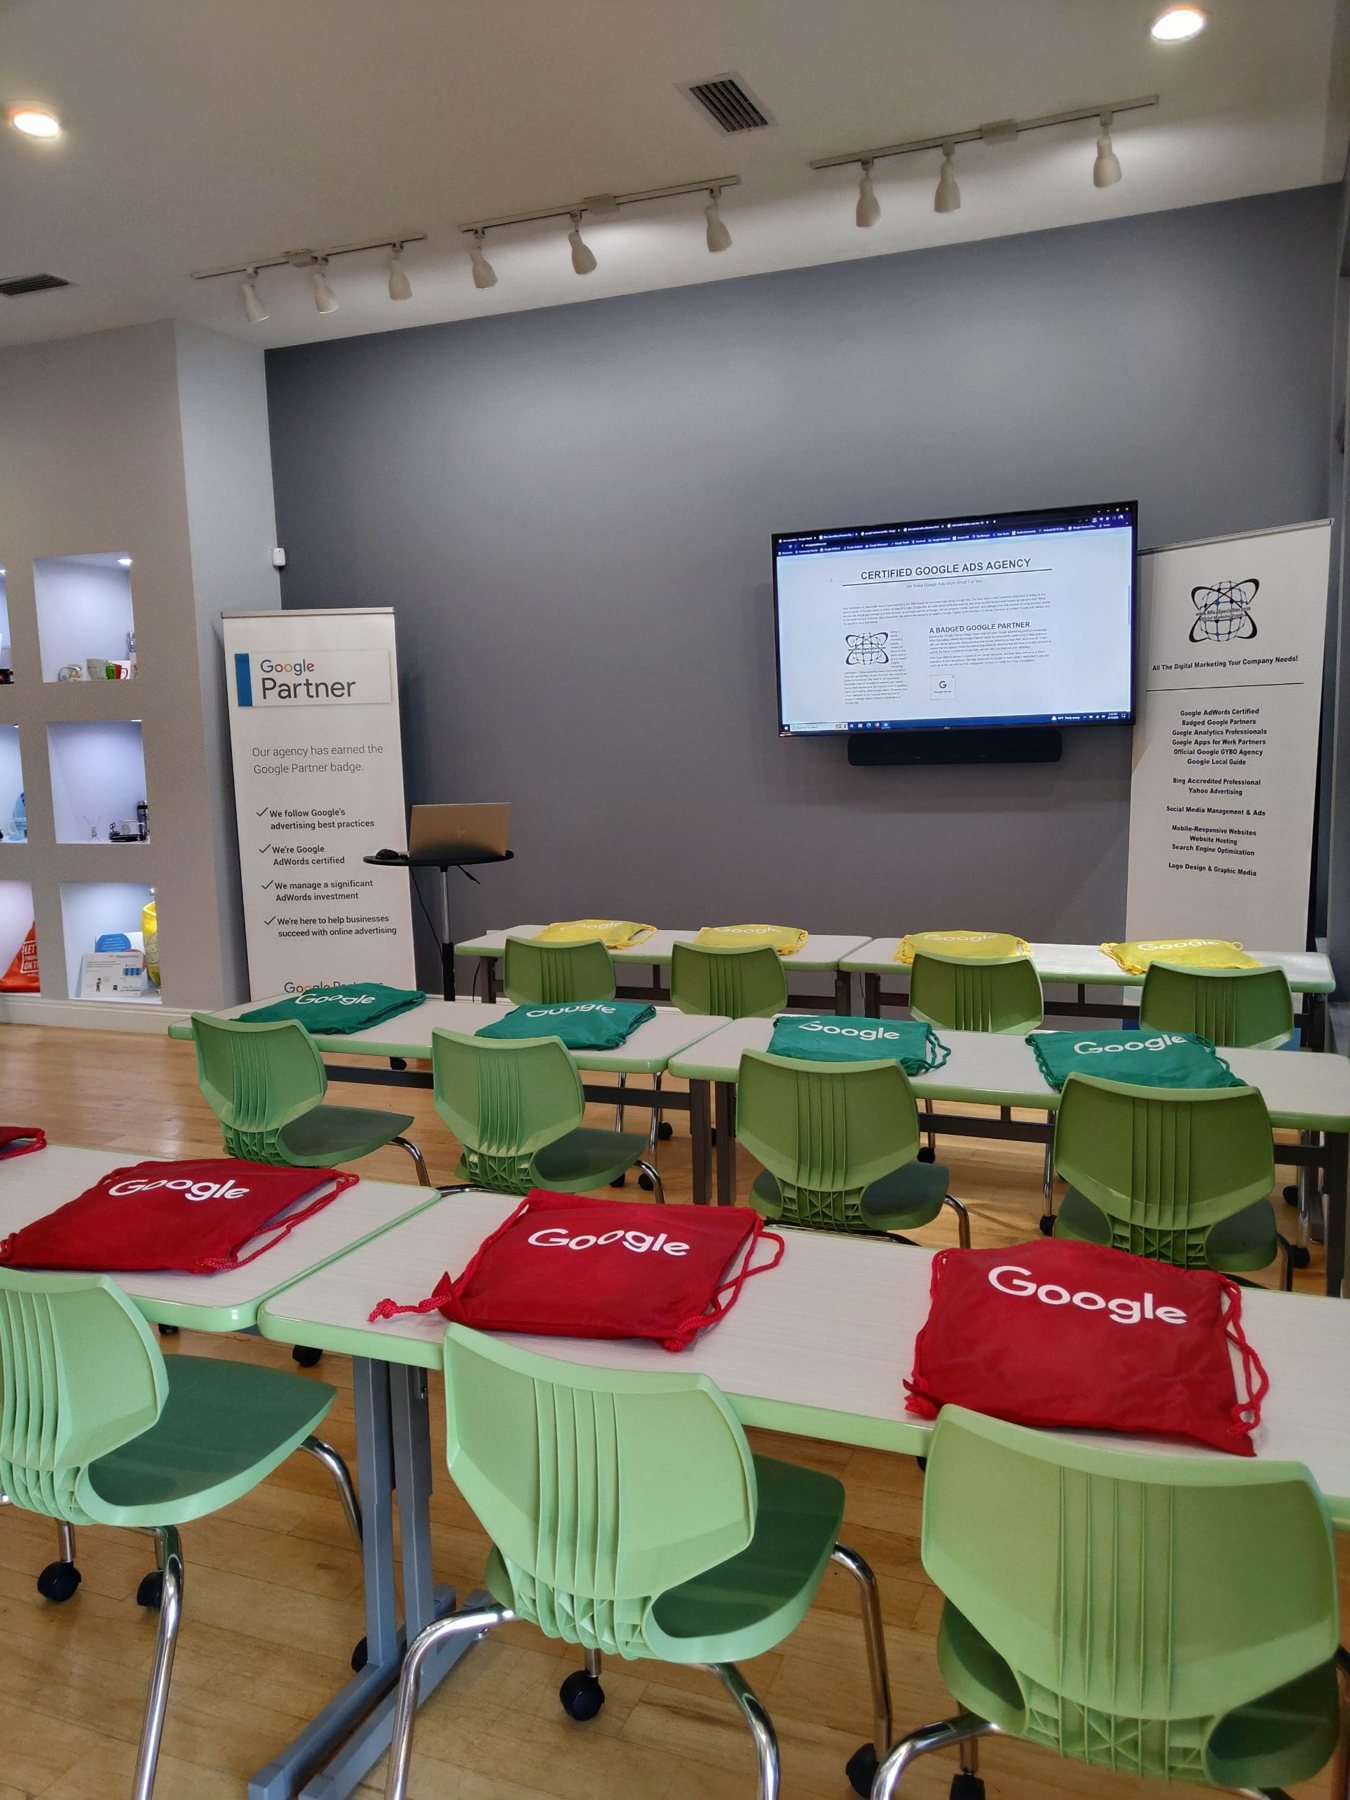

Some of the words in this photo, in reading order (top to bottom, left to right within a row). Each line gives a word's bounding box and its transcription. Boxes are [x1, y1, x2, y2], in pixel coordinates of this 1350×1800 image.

[861, 568, 912, 580] CERTIFIED
[915, 564, 959, 576] GOOGLE
[962, 562, 984, 573] ADS
[986, 558, 1031, 570] AGENCY
[966, 624, 996, 632] GOOGLE
[997, 621, 1030, 629] PARTNER
[260, 659, 315, 676] Google
[1174, 663, 1193, 671] Digital
[1194, 660, 1227, 668] Marketing
[1275, 655, 1298, 663] Needs!
[261, 677, 356, 700] Partner
[939, 680, 947, 689] G
[1180, 709, 1201, 717] Google
[252, 747, 270, 757] Our
[272, 746, 308, 758] agency
[310, 745, 329, 755] has
[331, 744, 364, 754] earned
[367, 744, 383, 754] the
[1197, 748, 1219, 756] Google
[1187, 758, 1210, 766] Google
[253, 764, 289, 776] Google
[291, 763, 328, 773] Partner
[330, 762, 363, 773] badge.
[1173, 777, 1185, 785] Bing
[1210, 788, 1243, 796] Advertising
[269, 810, 283, 818] We
[284, 809, 309, 817] follow
[311, 808, 346, 818] Google's
[270, 821, 316, 831] advertising
[317, 820, 336, 829] best
[337, 820, 375, 829] practices
[1172, 825, 1227, 834] Mobile-Responsive
[1229, 828, 1256, 836] Websites
[1189, 835, 1214, 843] Website
[1215, 837, 1237, 845] Hosting
[272, 845, 294, 854] We're
[296, 845, 325, 854] Google
[1195, 845, 1215, 853] Engine
[1217, 847, 1255, 856] Optimization
[273, 857, 309, 866] AdWords
[311, 856, 345, 864] certified
[1168, 862, 1183, 870] Logo
[1185, 864, 1206, 872] Design
[274, 882, 288, 890] We
[289, 881, 322, 890] manage
[330, 880, 373, 889] significant
[275, 893, 312, 902] AdWords
[313, 892, 359, 900] investment
[277, 917, 298, 925] We're
[299, 917, 317, 925] here
[327, 916, 345, 925] help
[346, 915, 390, 923] businesses
[278, 929, 310, 937] succeed
[311, 928, 328, 936] with
[329, 928, 353, 936] online
[354, 926, 397, 936] advertising
[1137, 940, 1220, 951] Google
[295, 993, 376, 1005] Google
[798, 1020, 900, 1041] Google
[1073, 1034, 1188, 1055] Google
[108, 1178, 250, 1201] Google
[528, 1228, 690, 1256] Google
[988, 1265, 1188, 1325] Google
